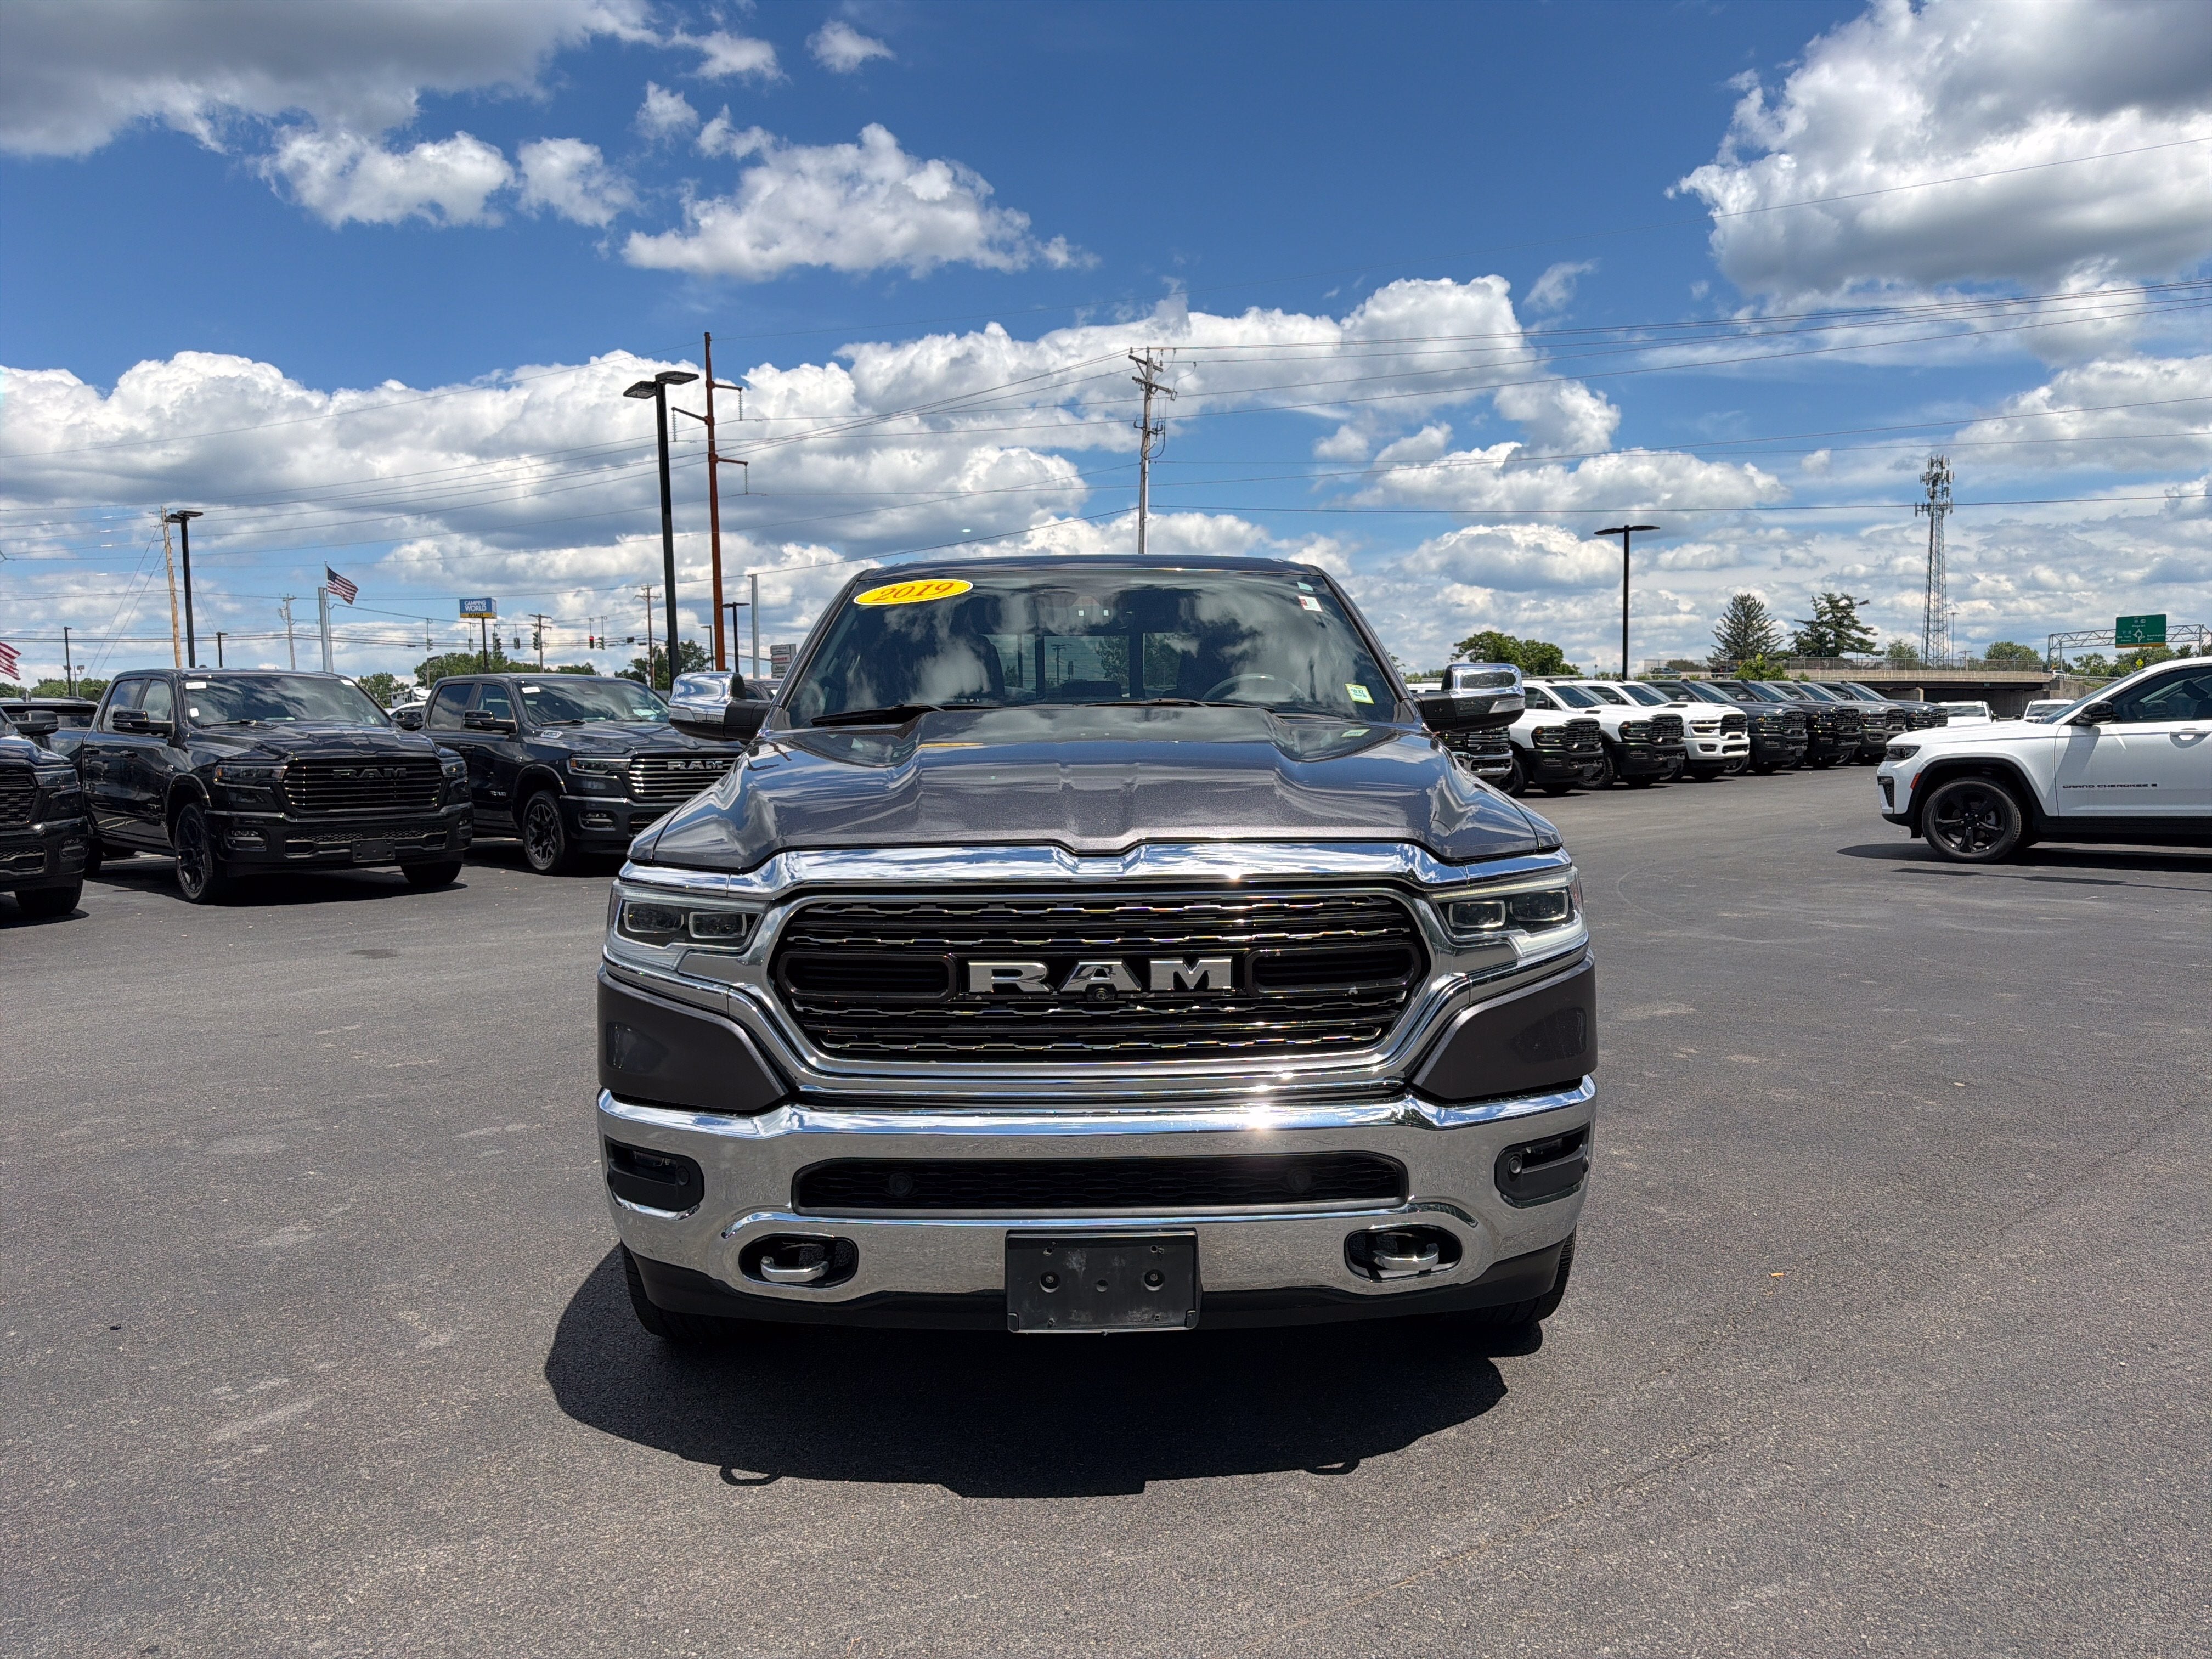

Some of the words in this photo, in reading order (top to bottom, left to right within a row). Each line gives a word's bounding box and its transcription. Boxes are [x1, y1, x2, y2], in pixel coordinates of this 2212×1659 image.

[872, 582, 955, 602] 2019
[333, 768, 407, 778] RAM
[667, 761, 723, 770] RAM
[968, 957, 1233, 992] RAM
